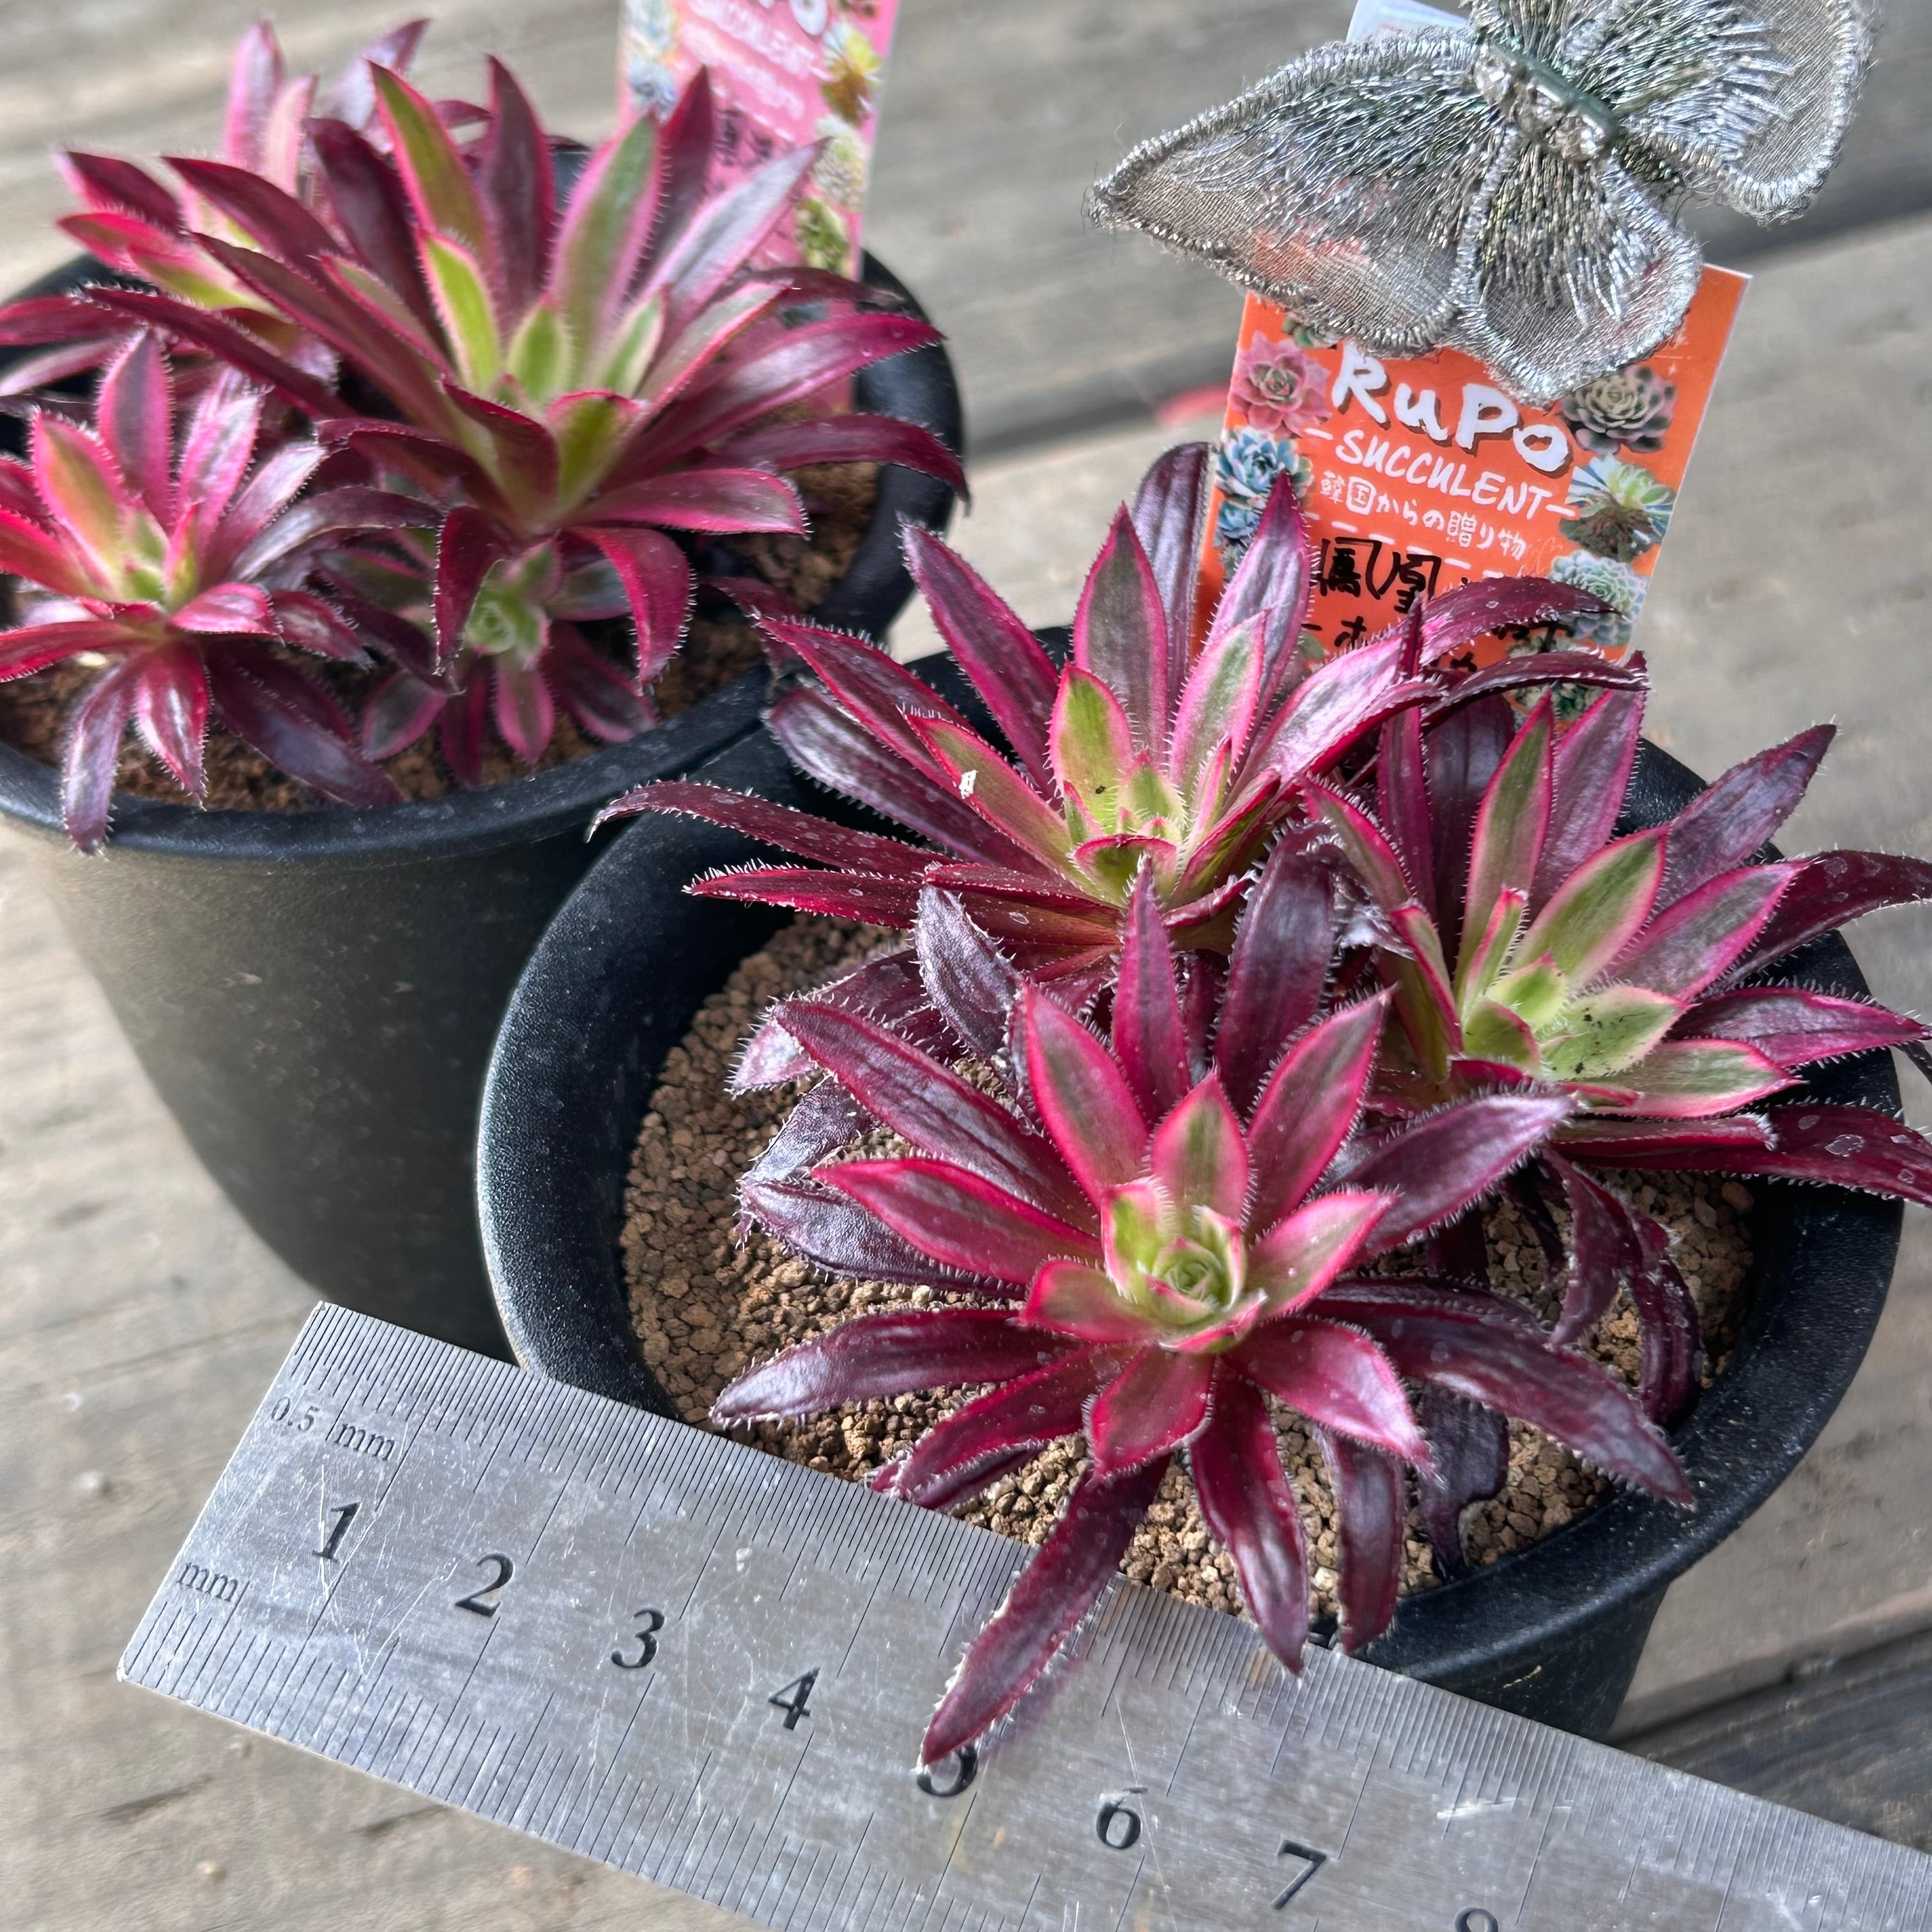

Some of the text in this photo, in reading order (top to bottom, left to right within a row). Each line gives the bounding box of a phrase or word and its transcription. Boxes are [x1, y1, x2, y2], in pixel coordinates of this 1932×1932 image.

[1320, 470, 1528, 561] 韓国からの贈り物
[270, 1395, 397, 1463] 0.5 mm
[174, 1560, 241, 1604] mm
[312, 1501, 364, 1563] 1
[455, 1553, 514, 1618] 2
[610, 1608, 666, 1669] 3
[767, 1667, 821, 1731] 4
[1095, 1787, 1149, 1850] 6
[1271, 1839, 1328, 1910] 7
